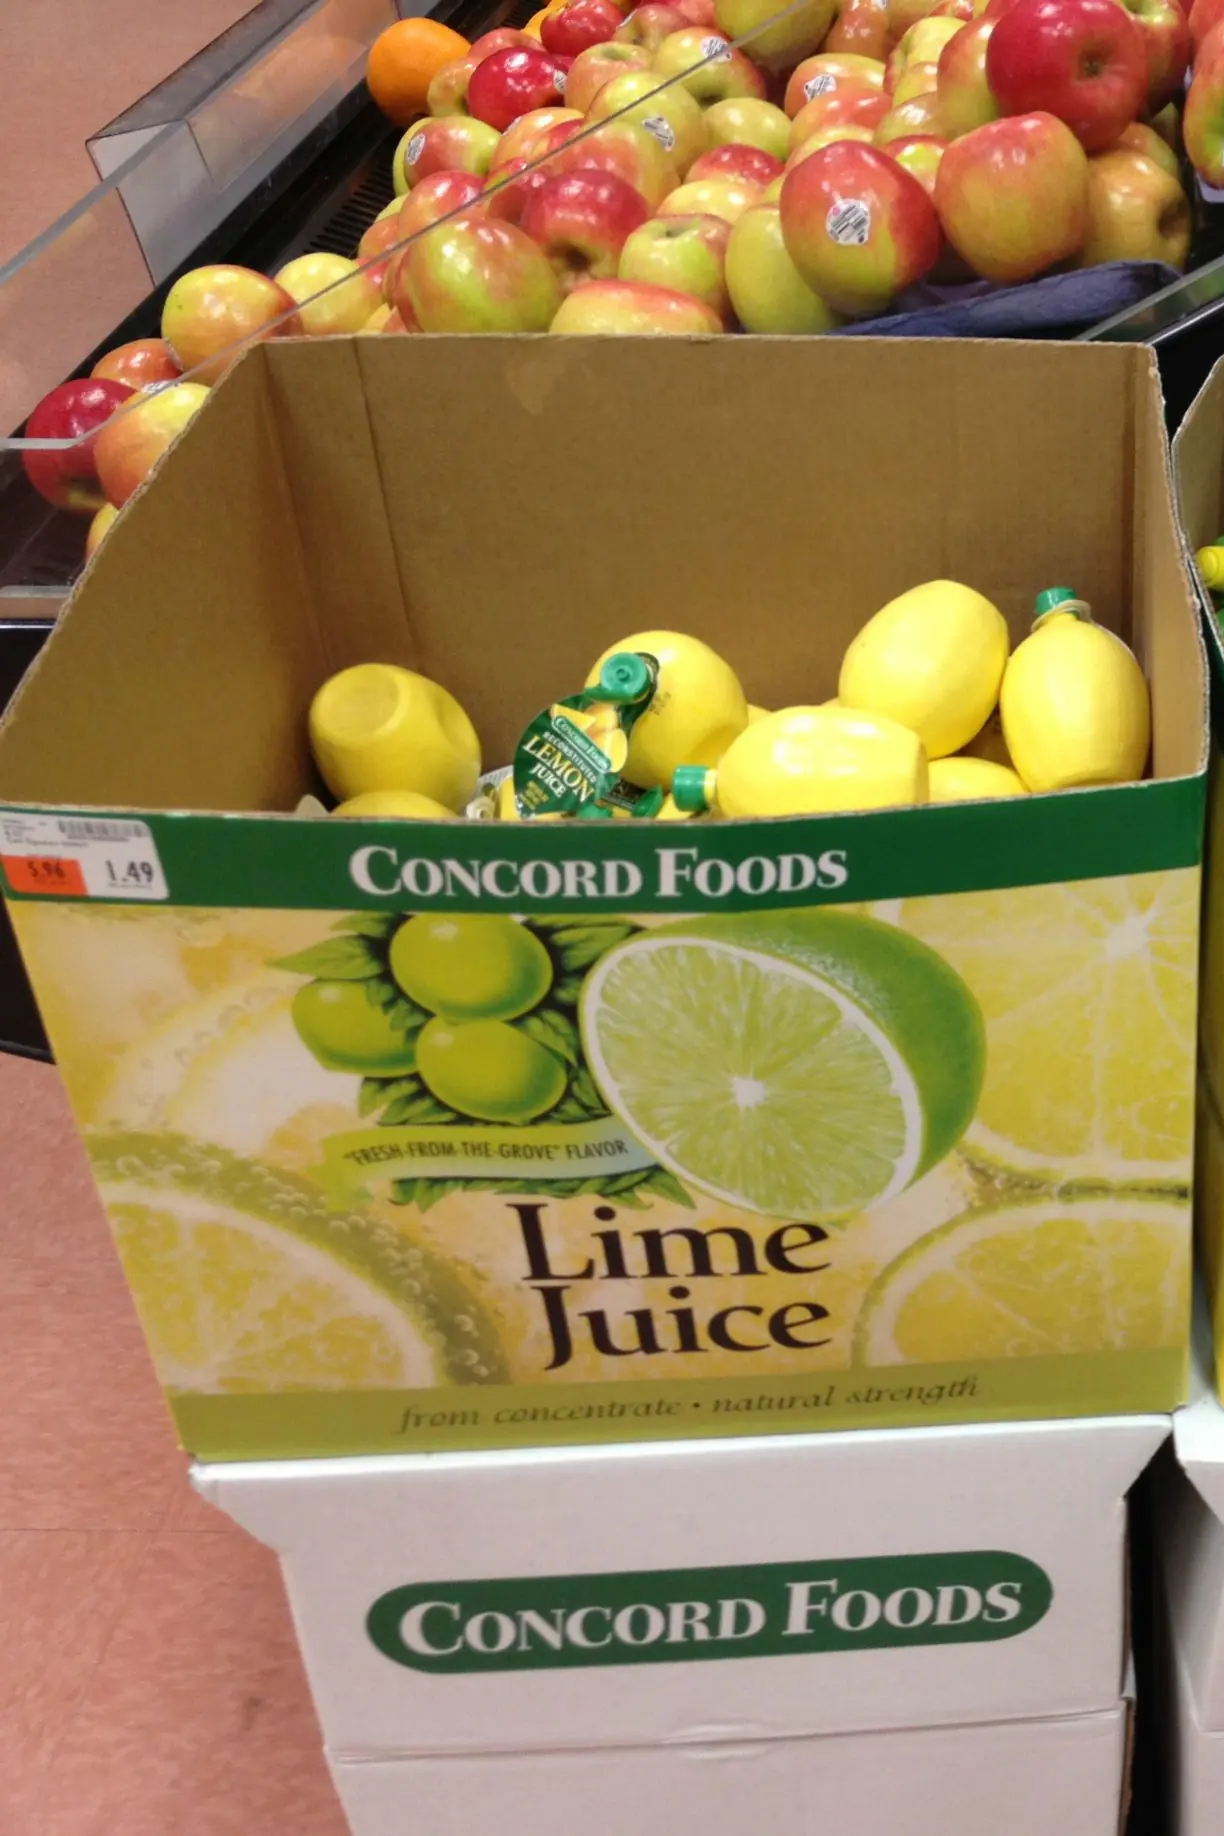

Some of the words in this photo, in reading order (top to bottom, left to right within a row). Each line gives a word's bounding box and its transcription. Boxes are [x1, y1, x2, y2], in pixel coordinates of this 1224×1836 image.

[522, 735, 595, 803] LEMON
[526, 763, 568, 798] JUICE
[26, 860, 67, 879] 5.96
[105, 859, 155, 883] 1.49
[348, 845, 643, 898] CONCORD
[655, 848, 849, 898] FOODS
[565, 1139, 630, 1160] FLAVOR
[506, 1202, 832, 1282] Lime
[531, 1285, 833, 1371] Juice
[395, 1404, 480, 1436] from
[492, 1396, 682, 1425] concentrate
[711, 1385, 836, 1415] natural
[844, 1373, 981, 1408] strength
[398, 1597, 767, 1656] CONCORD
[781, 1578, 1023, 1636] FOODS
